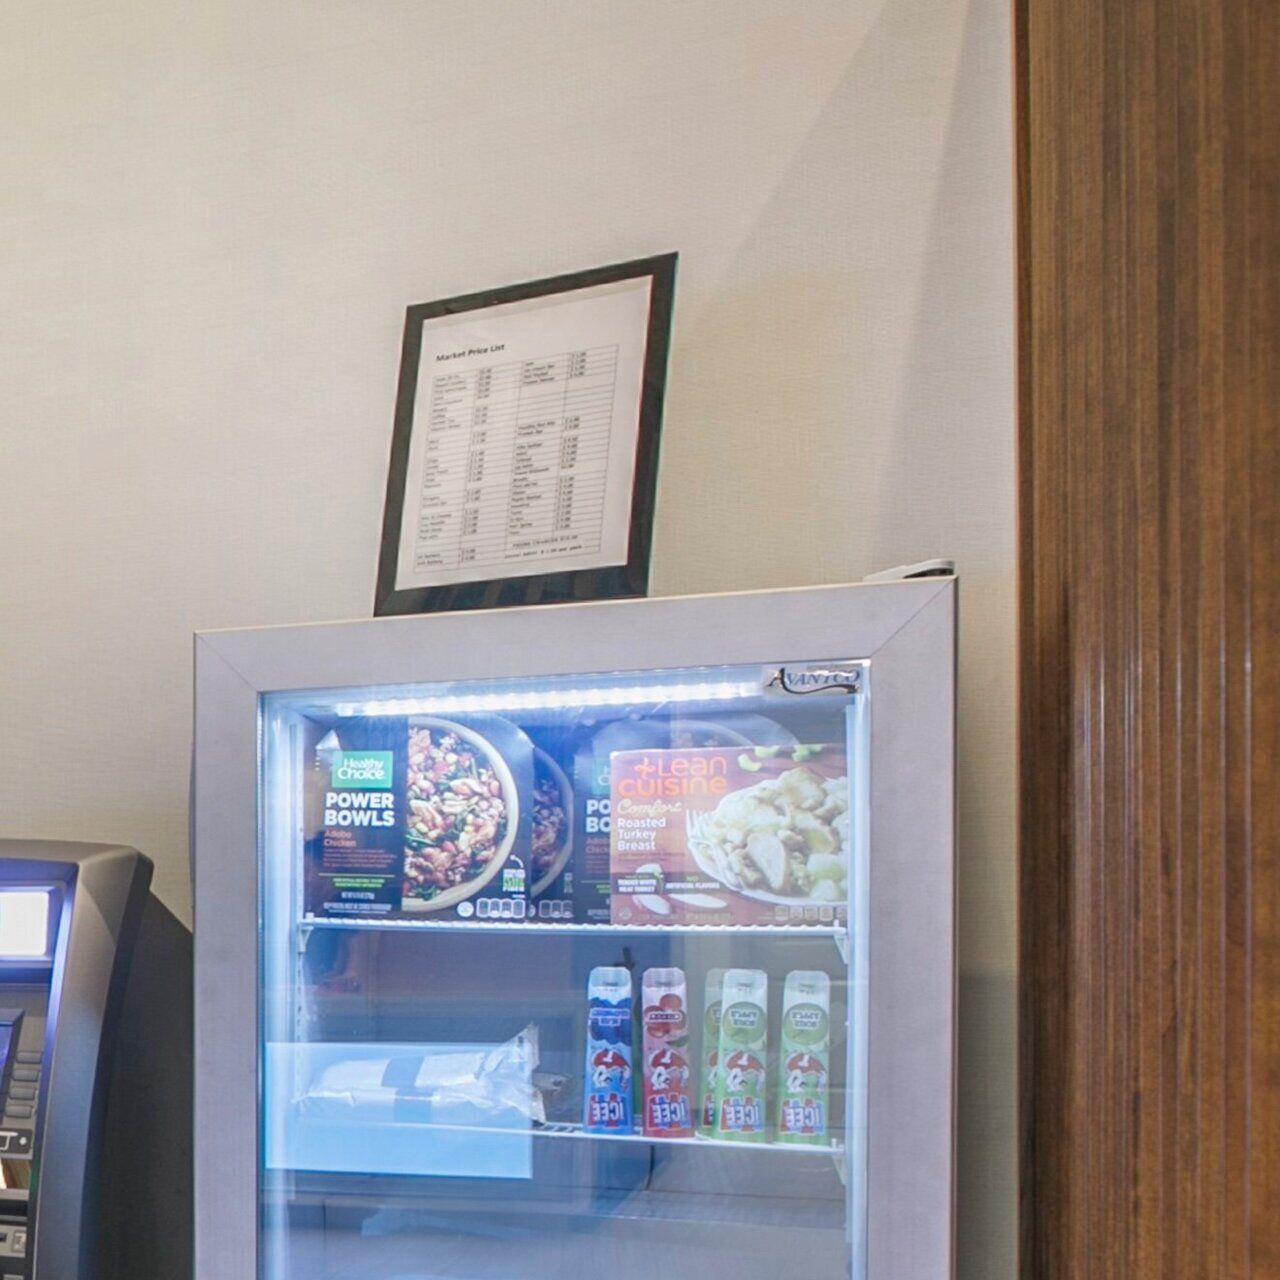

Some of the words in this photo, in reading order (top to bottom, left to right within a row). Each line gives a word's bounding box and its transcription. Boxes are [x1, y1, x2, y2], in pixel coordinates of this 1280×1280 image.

[435, 351, 466, 361] Market
[468, 347, 488, 356] Price
[490, 344, 505, 352] List
[344, 758, 384, 771] Healthy
[657, 756, 727, 777] Lean
[337, 768, 385, 780] Choice
[325, 792, 395, 809] POWER
[617, 799, 682, 817] Comfort
[325, 809, 395, 827] BOWLS
[617, 817, 666, 828] Roasted
[323, 838, 357, 848] Chicken
[324, 830, 353, 839] Adobo
[617, 829, 657, 841] Turkey
[617, 840, 656, 851] Breast
[591, 1101, 625, 1121] ICEE
[652, 1102, 687, 1124] ICEE
[725, 1103, 760, 1126] ICEE
[785, 1104, 820, 1128] ICEE
